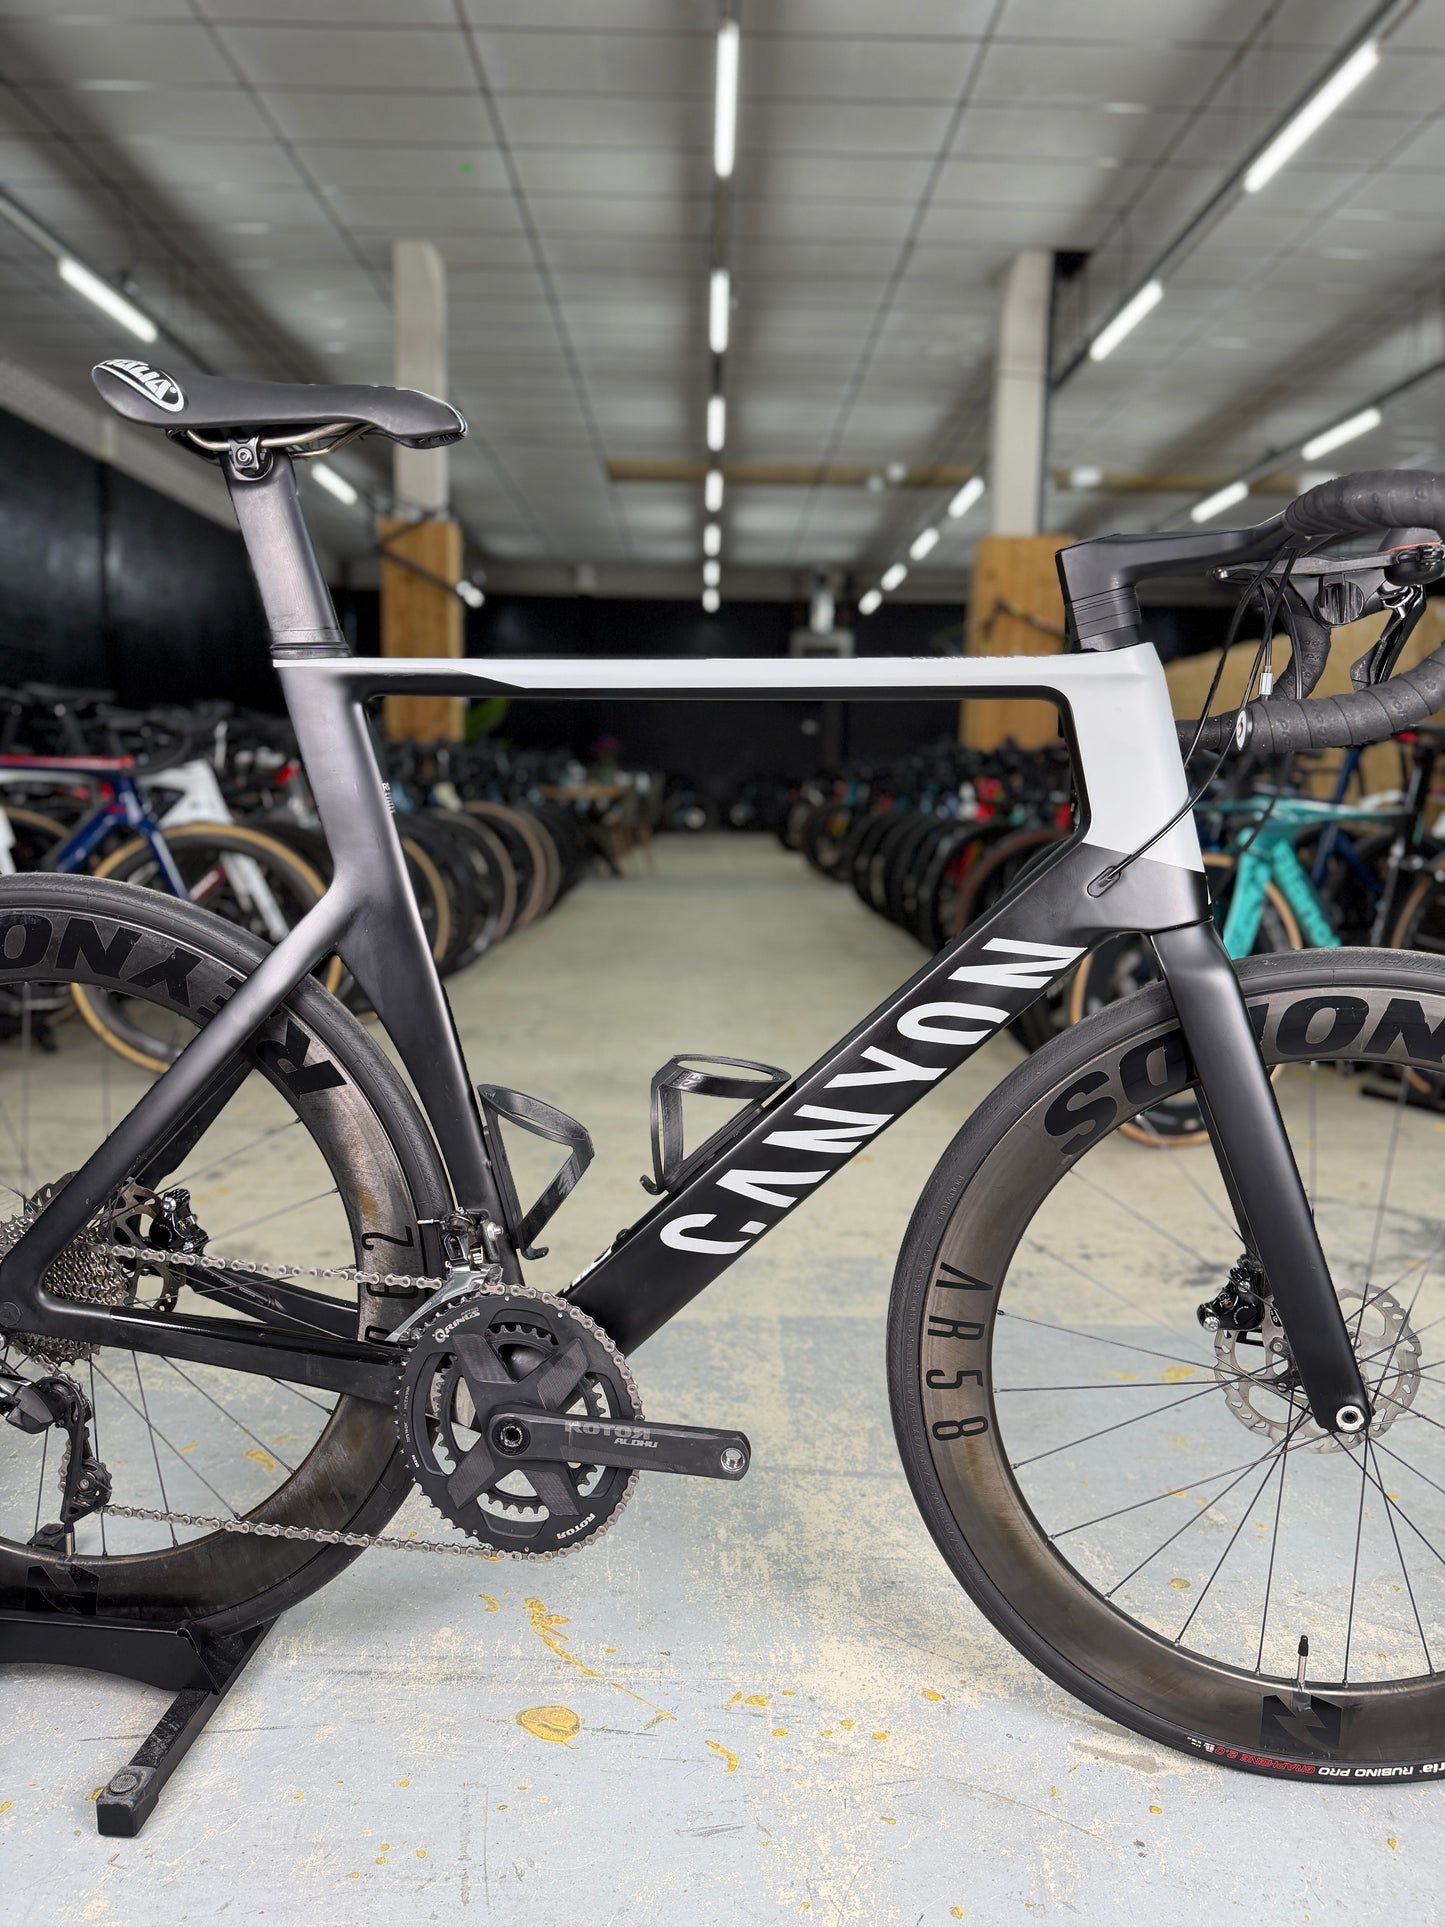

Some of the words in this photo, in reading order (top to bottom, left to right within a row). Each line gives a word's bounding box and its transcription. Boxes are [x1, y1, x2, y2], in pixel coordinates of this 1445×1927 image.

[660, 937, 1088, 1255] CANYON
[564, 1420, 651, 1440] ROTOR
[556, 1512, 596, 1540] ROTOR
[1240, 1753, 1316, 1774] GRAPHENE
[1318, 1766, 1351, 1777] PRO
[1354, 1765, 1414, 1777] RUBINO
